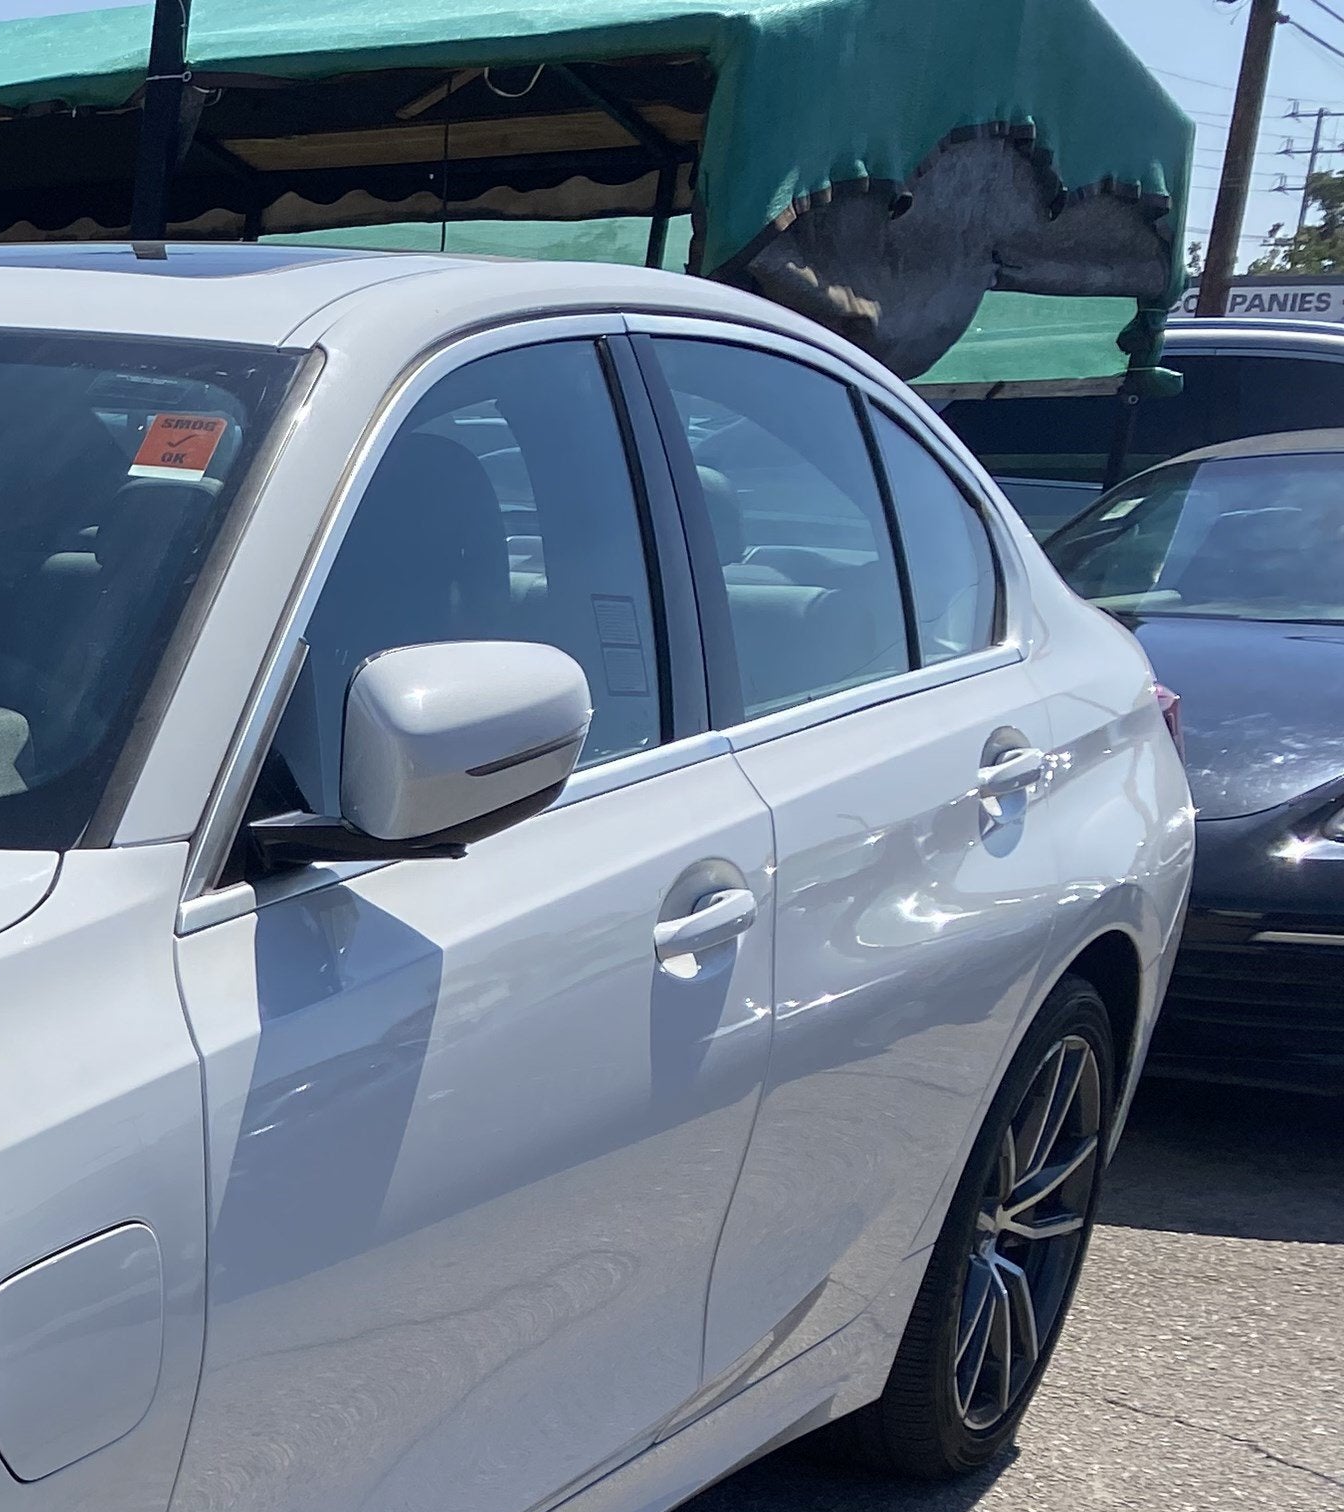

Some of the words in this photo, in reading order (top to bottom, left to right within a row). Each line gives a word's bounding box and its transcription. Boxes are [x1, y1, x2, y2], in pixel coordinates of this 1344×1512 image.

[1169, 292, 1332, 314] OPANIES
[161, 417, 217, 432] SMOG
[161, 451, 187, 464] OK
